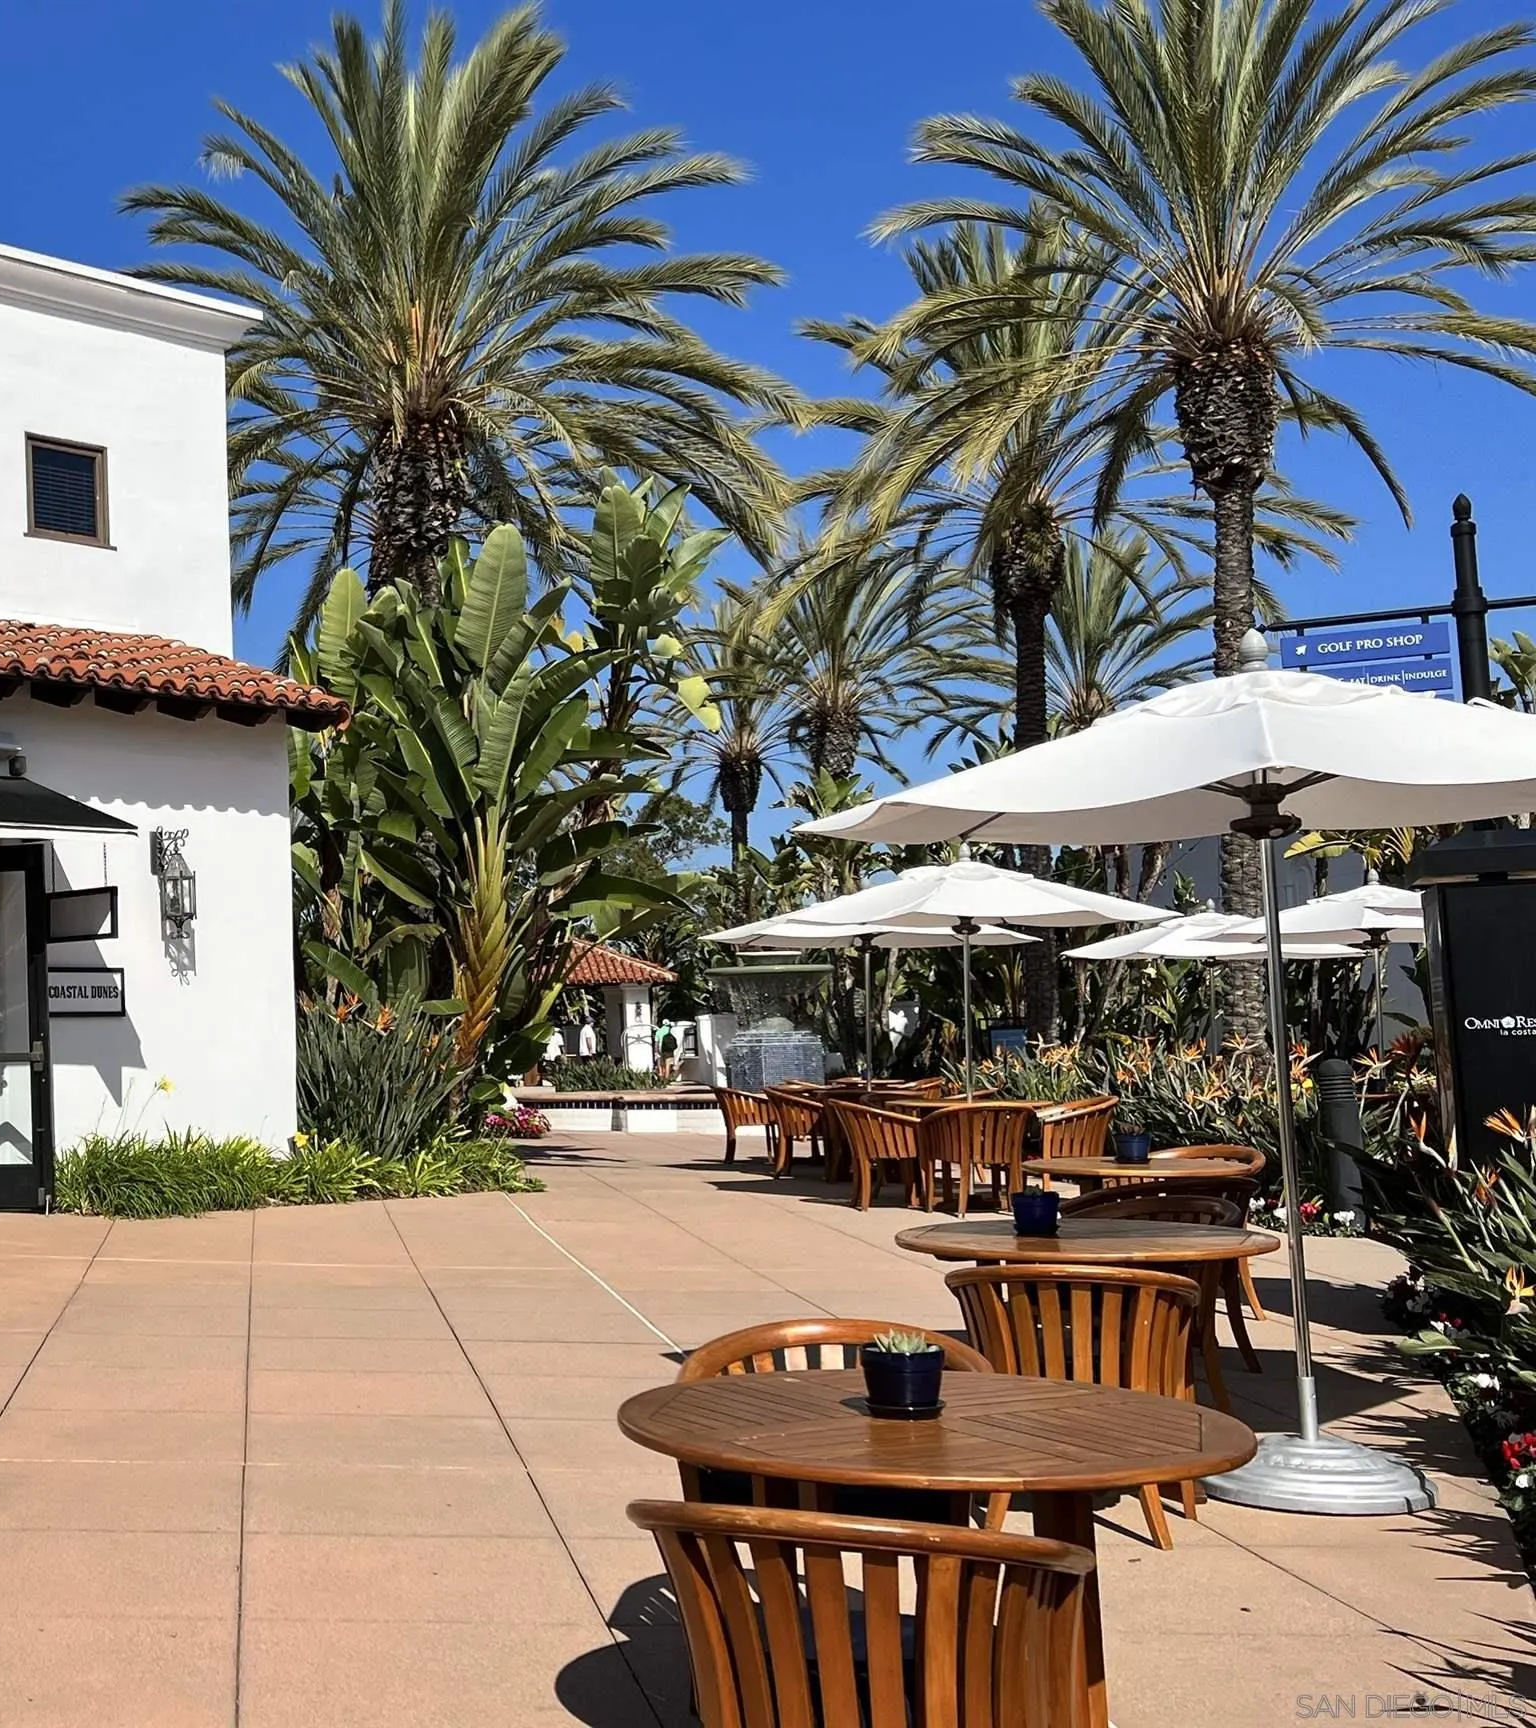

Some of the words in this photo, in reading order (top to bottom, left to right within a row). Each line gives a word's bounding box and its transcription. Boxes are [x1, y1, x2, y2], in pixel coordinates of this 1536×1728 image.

[1317, 640, 1353, 655] GOLF
[1357, 637, 1383, 650] PRO
[1386, 634, 1423, 648] SHOP
[48, 985, 89, 999] COASTAL
[91, 985, 119, 999] DUNES
[1464, 1017, 1500, 1030] OMNI
